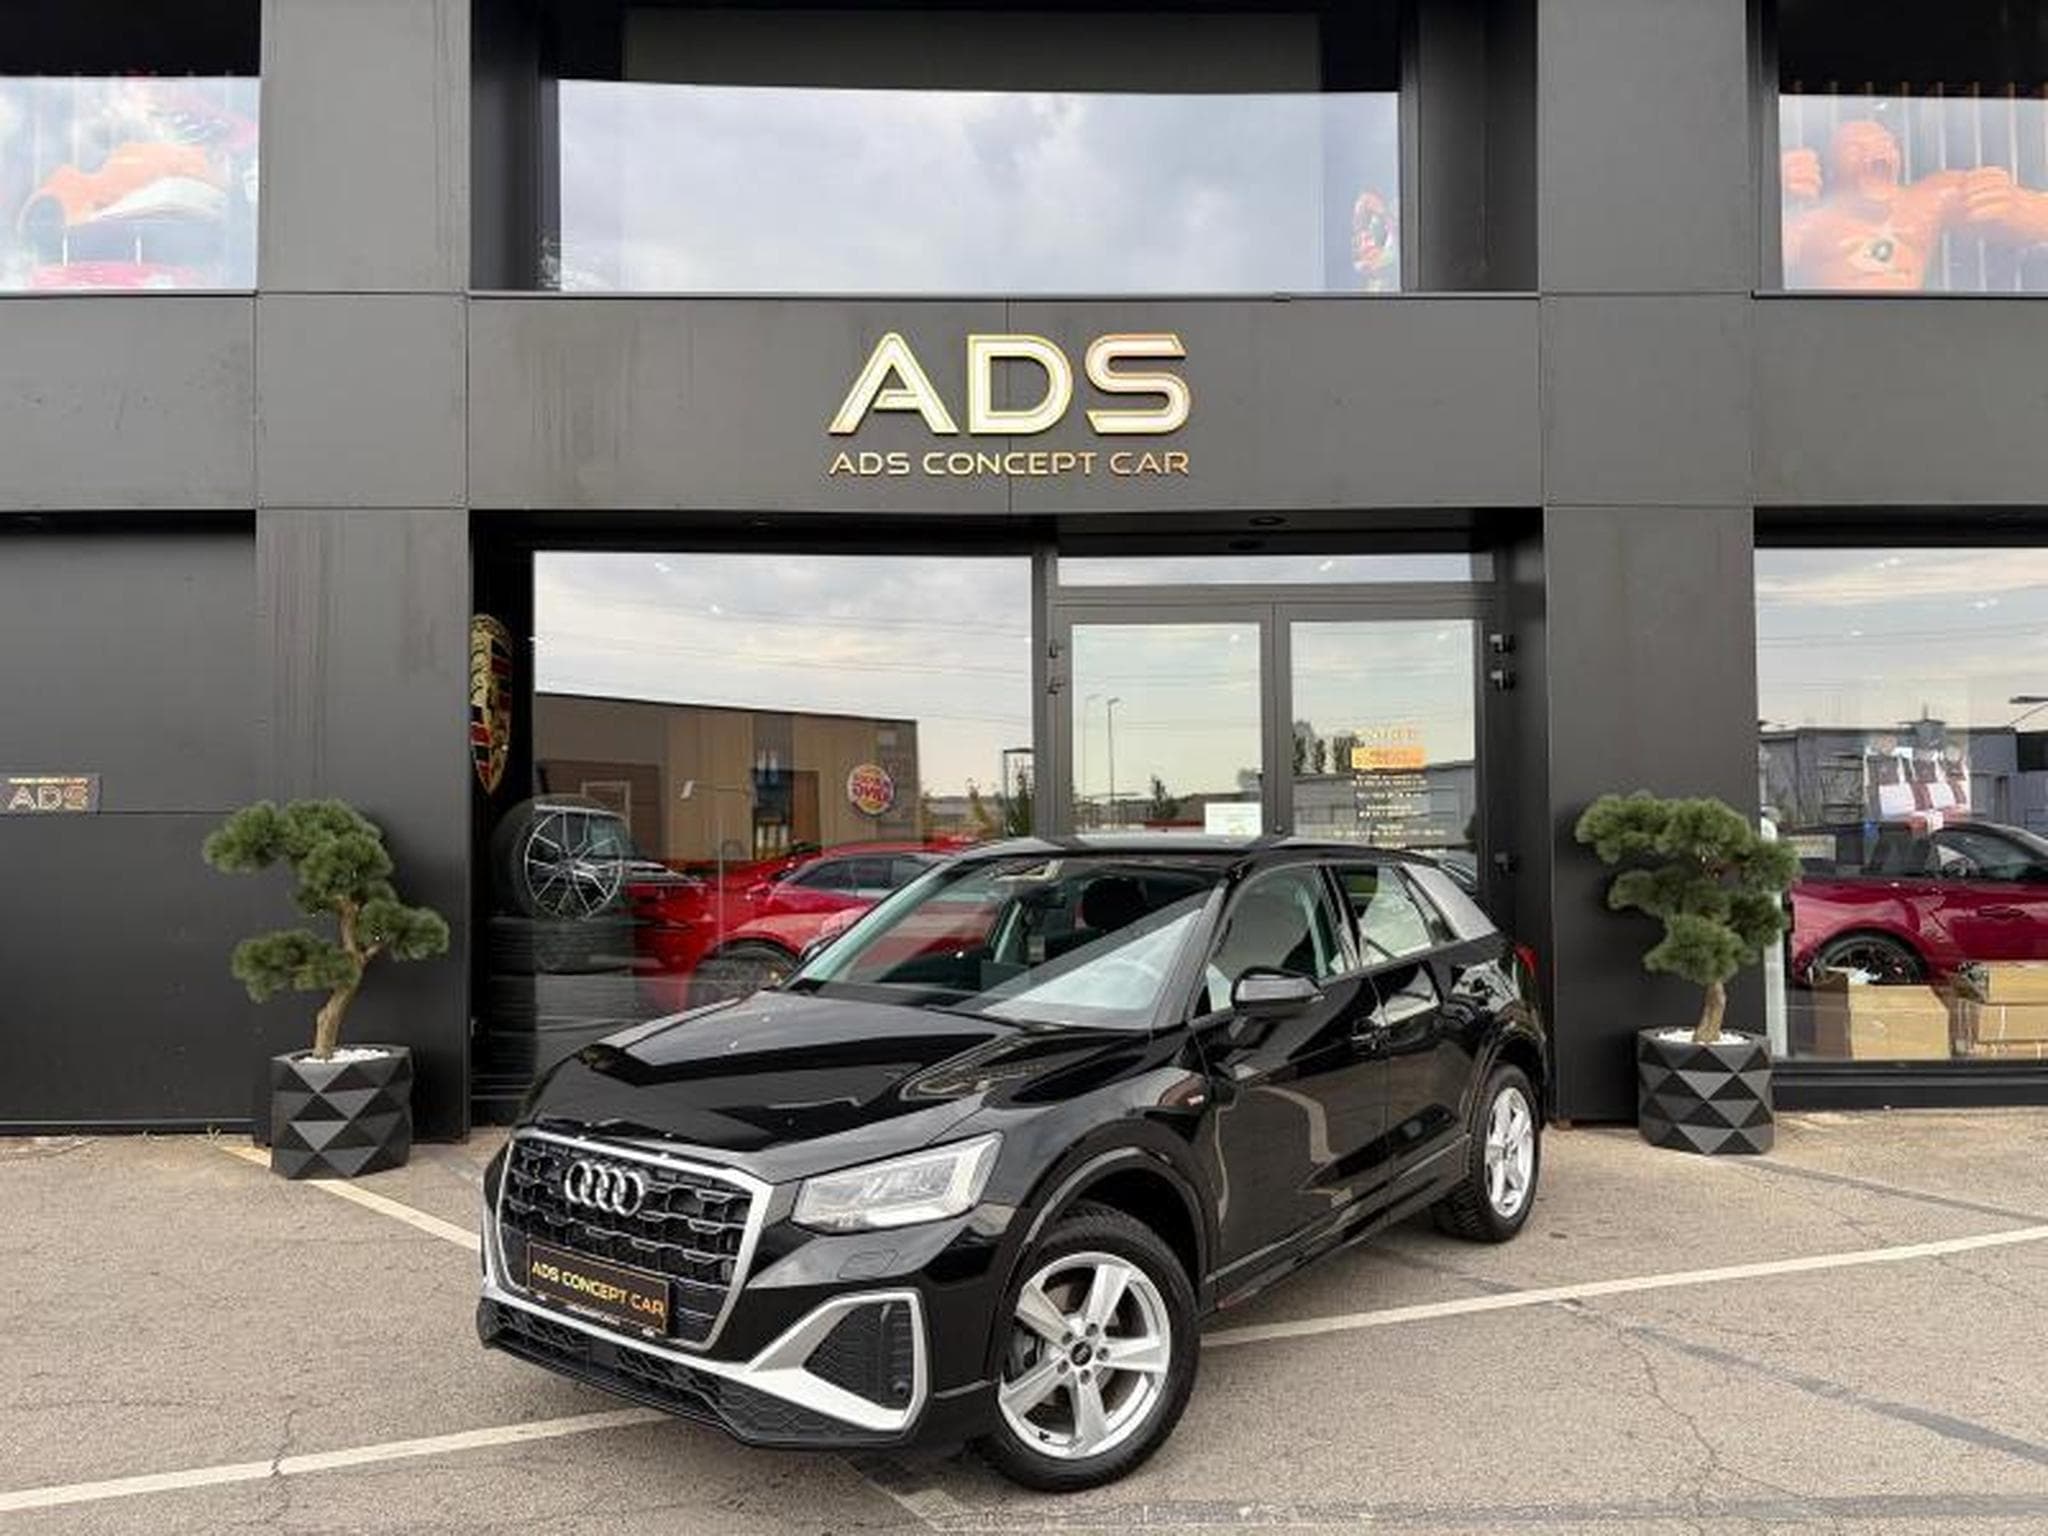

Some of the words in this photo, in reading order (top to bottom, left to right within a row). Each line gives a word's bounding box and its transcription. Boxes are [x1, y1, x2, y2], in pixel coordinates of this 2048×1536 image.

[827, 331, 1192, 436] ADS
[829, 452, 910, 476] ADS
[923, 451, 1097, 476] CONCEPT
[1110, 452, 1190, 476] CAR
[8, 785, 88, 811] ADS
[531, 1261, 559, 1282] ADS
[561, 1271, 627, 1304] CONCEPT
[630, 1293, 665, 1316] CAR
